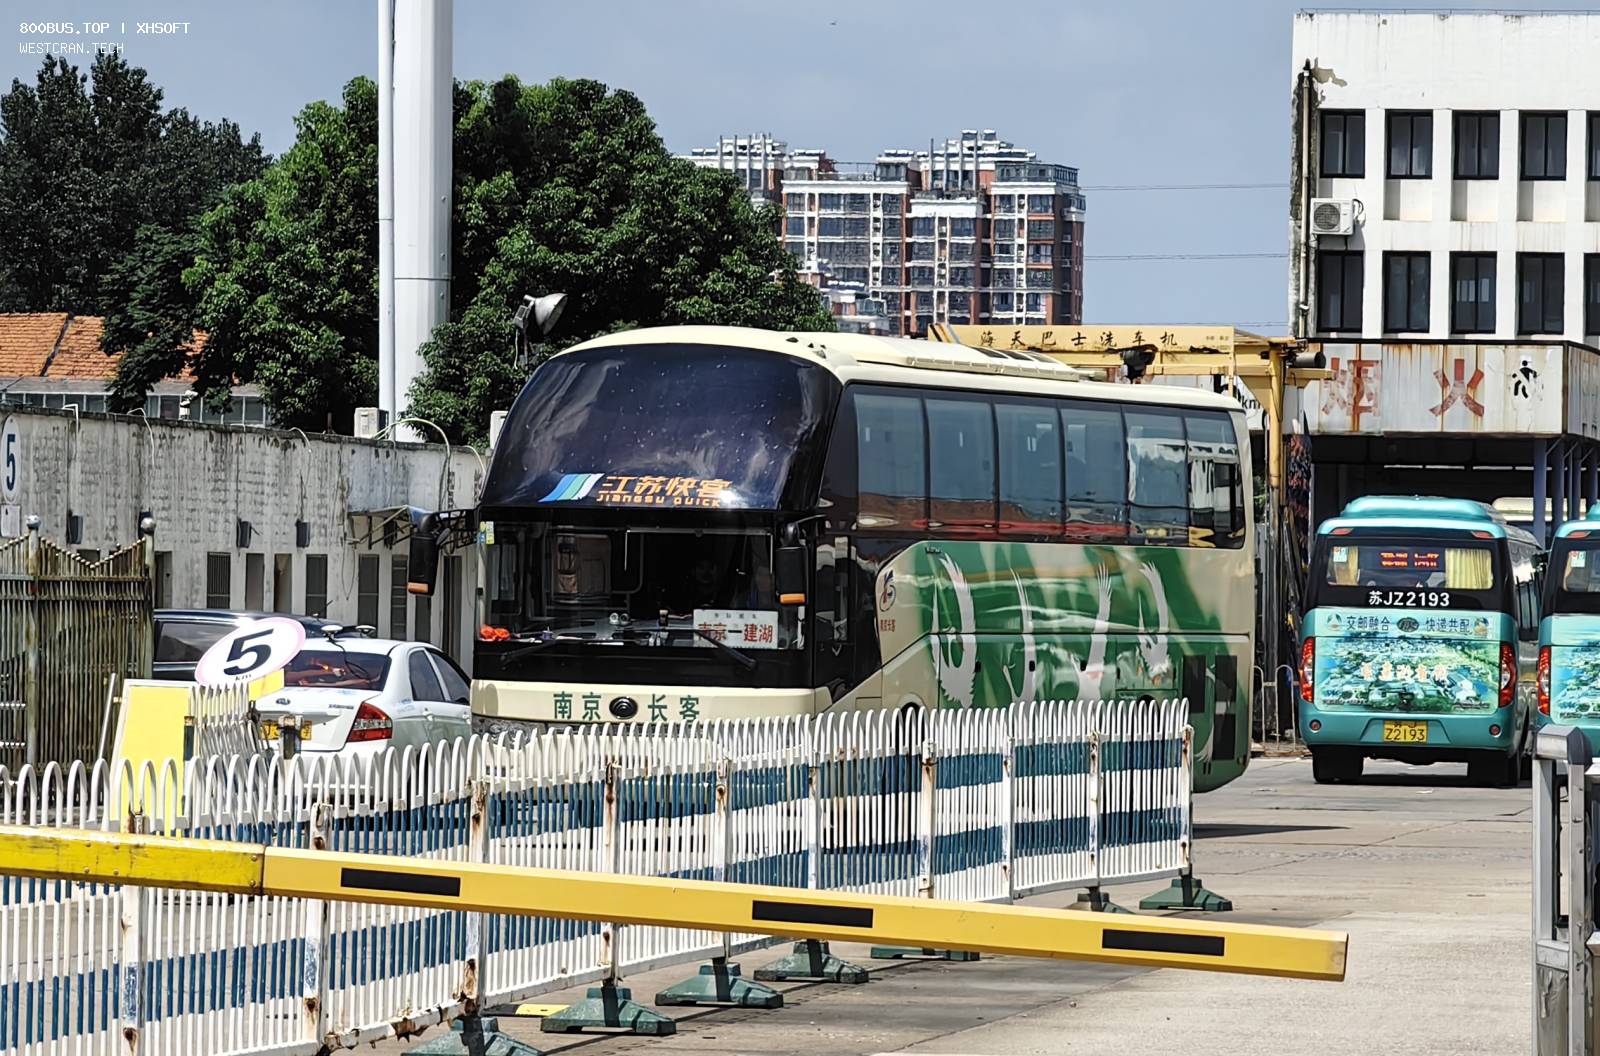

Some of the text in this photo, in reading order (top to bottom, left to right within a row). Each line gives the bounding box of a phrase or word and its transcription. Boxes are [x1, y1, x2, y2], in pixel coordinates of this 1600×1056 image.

[6, 433, 16, 492] 5
[1368, 590, 1450, 607] 苏JZ2193
[223, 628, 274, 676] 5
[553, 691, 700, 725] 南京 长客
[1385, 728, 1425, 741] Z2193
